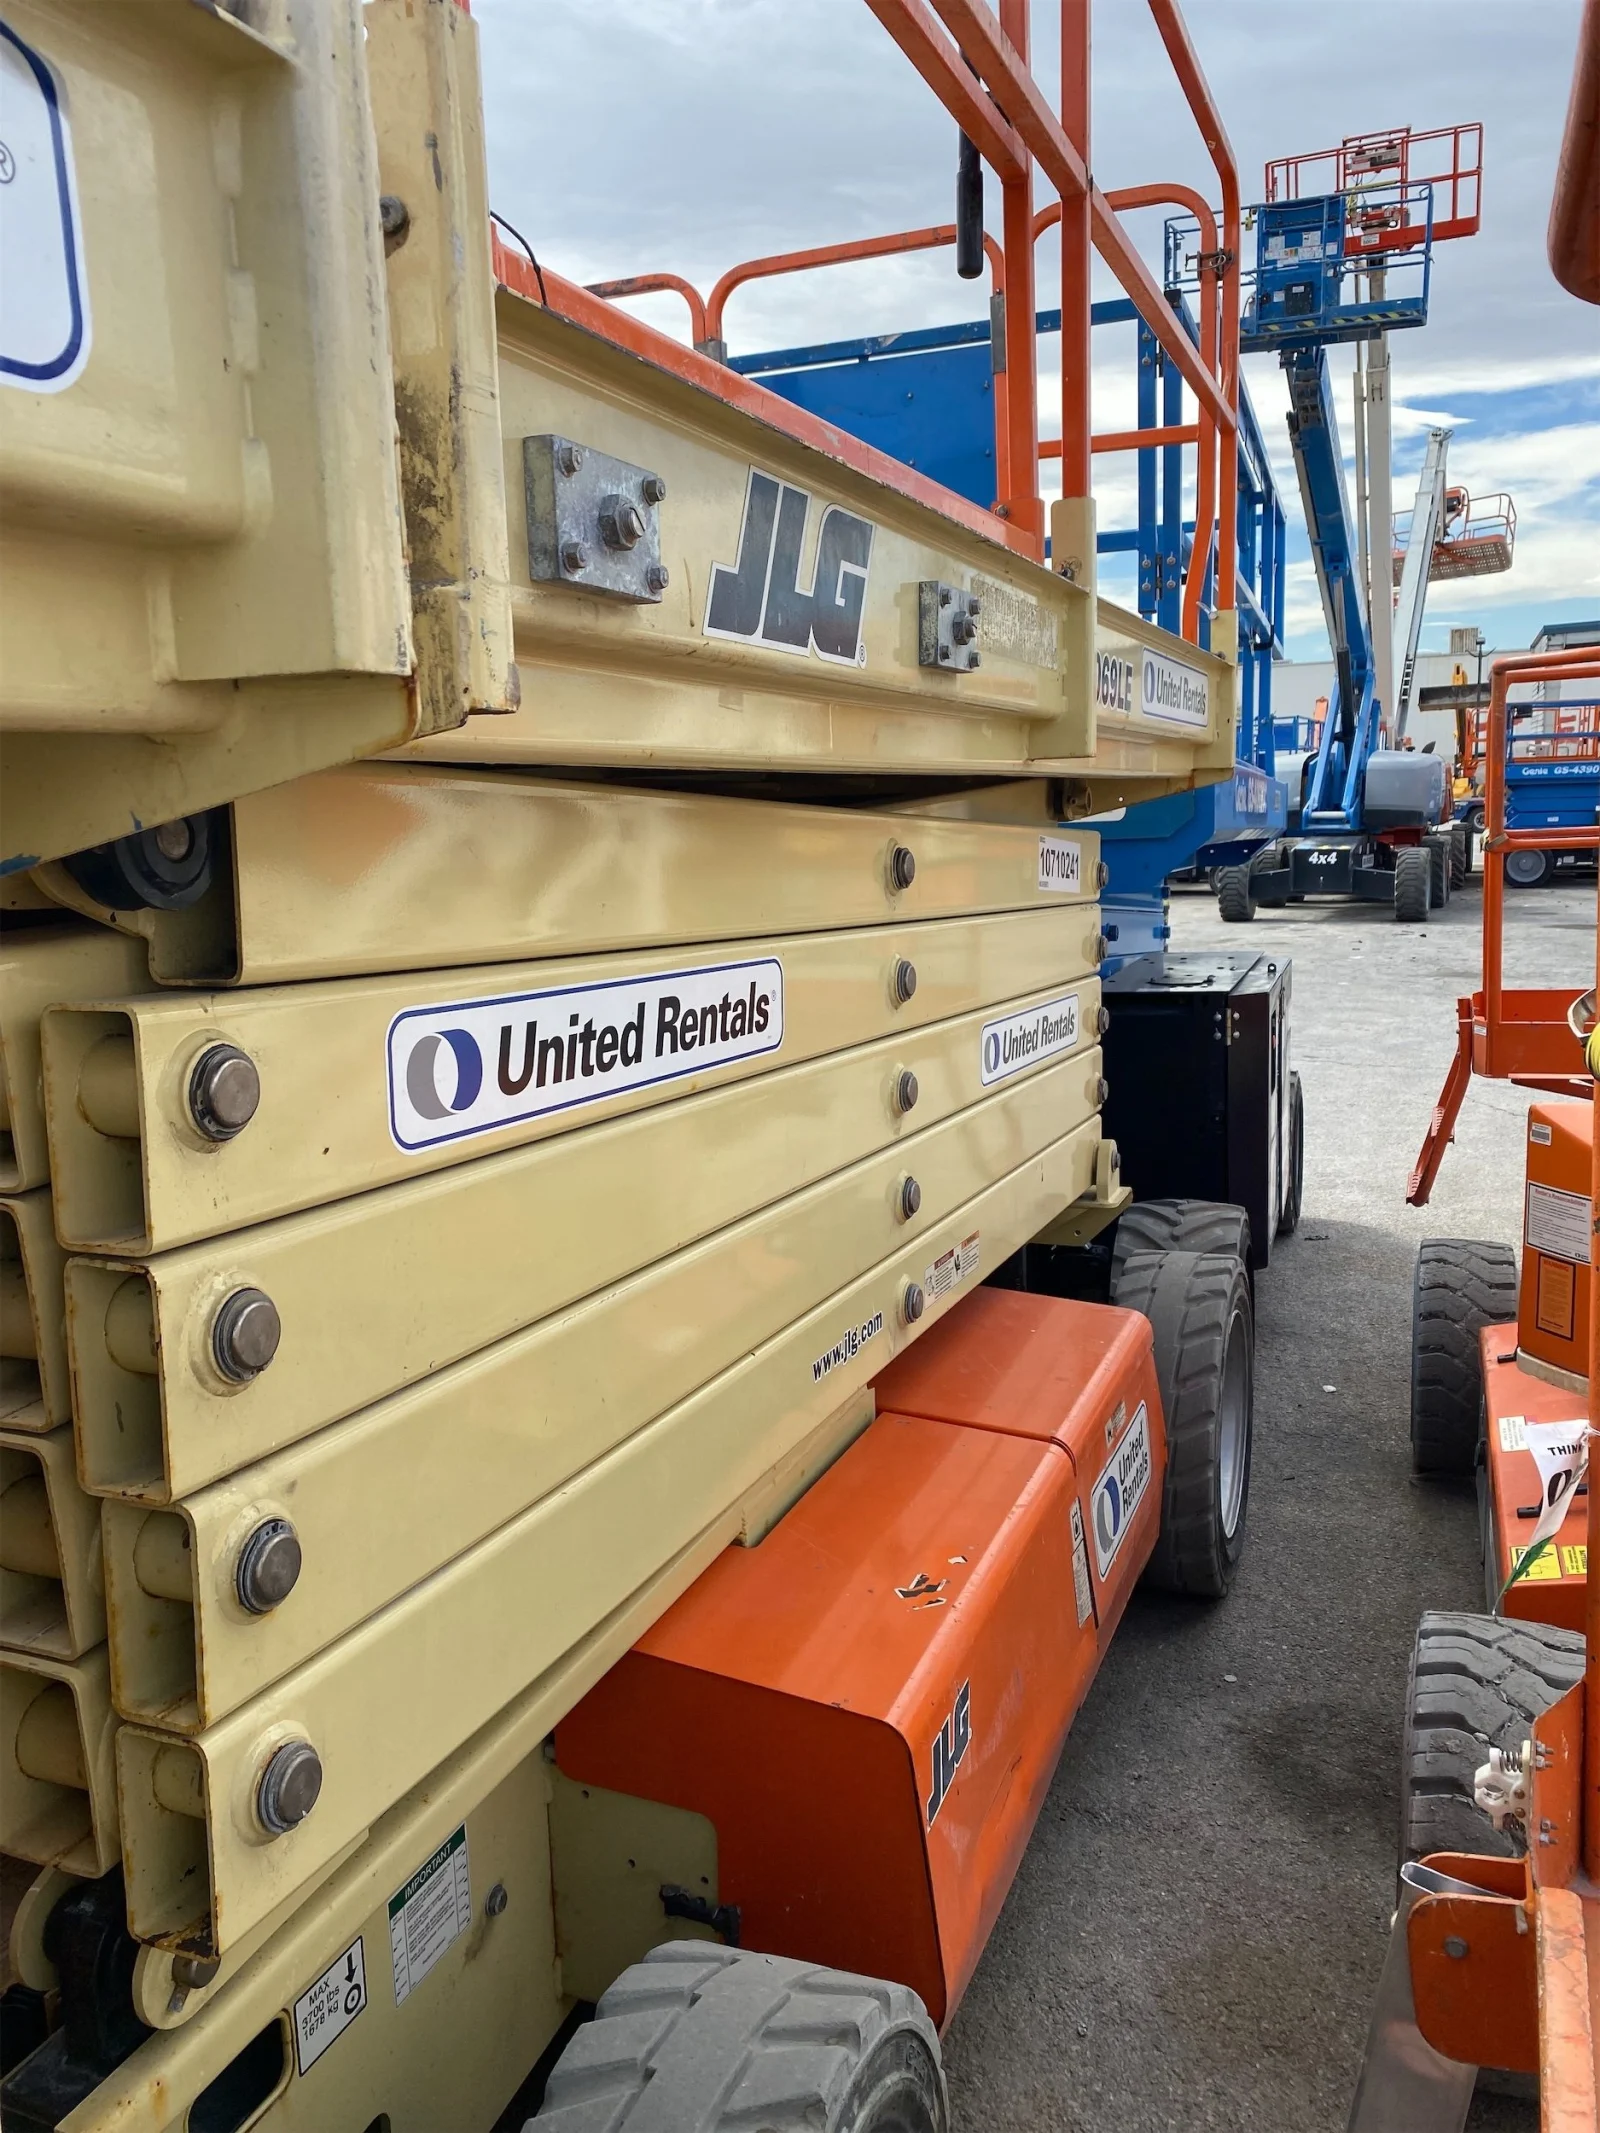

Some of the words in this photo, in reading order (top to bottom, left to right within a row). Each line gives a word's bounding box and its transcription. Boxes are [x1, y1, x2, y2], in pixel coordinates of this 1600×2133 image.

[705, 467, 875, 666] JLG
[1157, 667, 1182, 709] United
[1183, 677, 1206, 715] Rentals
[1522, 767, 1548, 776] Genie
[1041, 847, 1079, 880] 10710241
[1308, 851, 1337, 865] 4x4
[498, 1002, 646, 1096] United
[655, 981, 770, 1058] Rentals
[1002, 1018, 1039, 1064] United
[1041, 1006, 1075, 1047] Rentals
[813, 1312, 883, 1381] www.jlg.com
[1118, 1419, 1144, 1481] United
[1122, 1451, 1149, 1517] Rentals
[927, 1679, 970, 1828] JLG
[404, 1843, 452, 1900] IMPORTANT
[302, 2000, 324, 2030] 3700
[326, 1985, 340, 2004] lbs
[309, 1977, 330, 2006] MAX
[303, 2012, 325, 2041] 1678
[328, 2000, 339, 2017] kg
